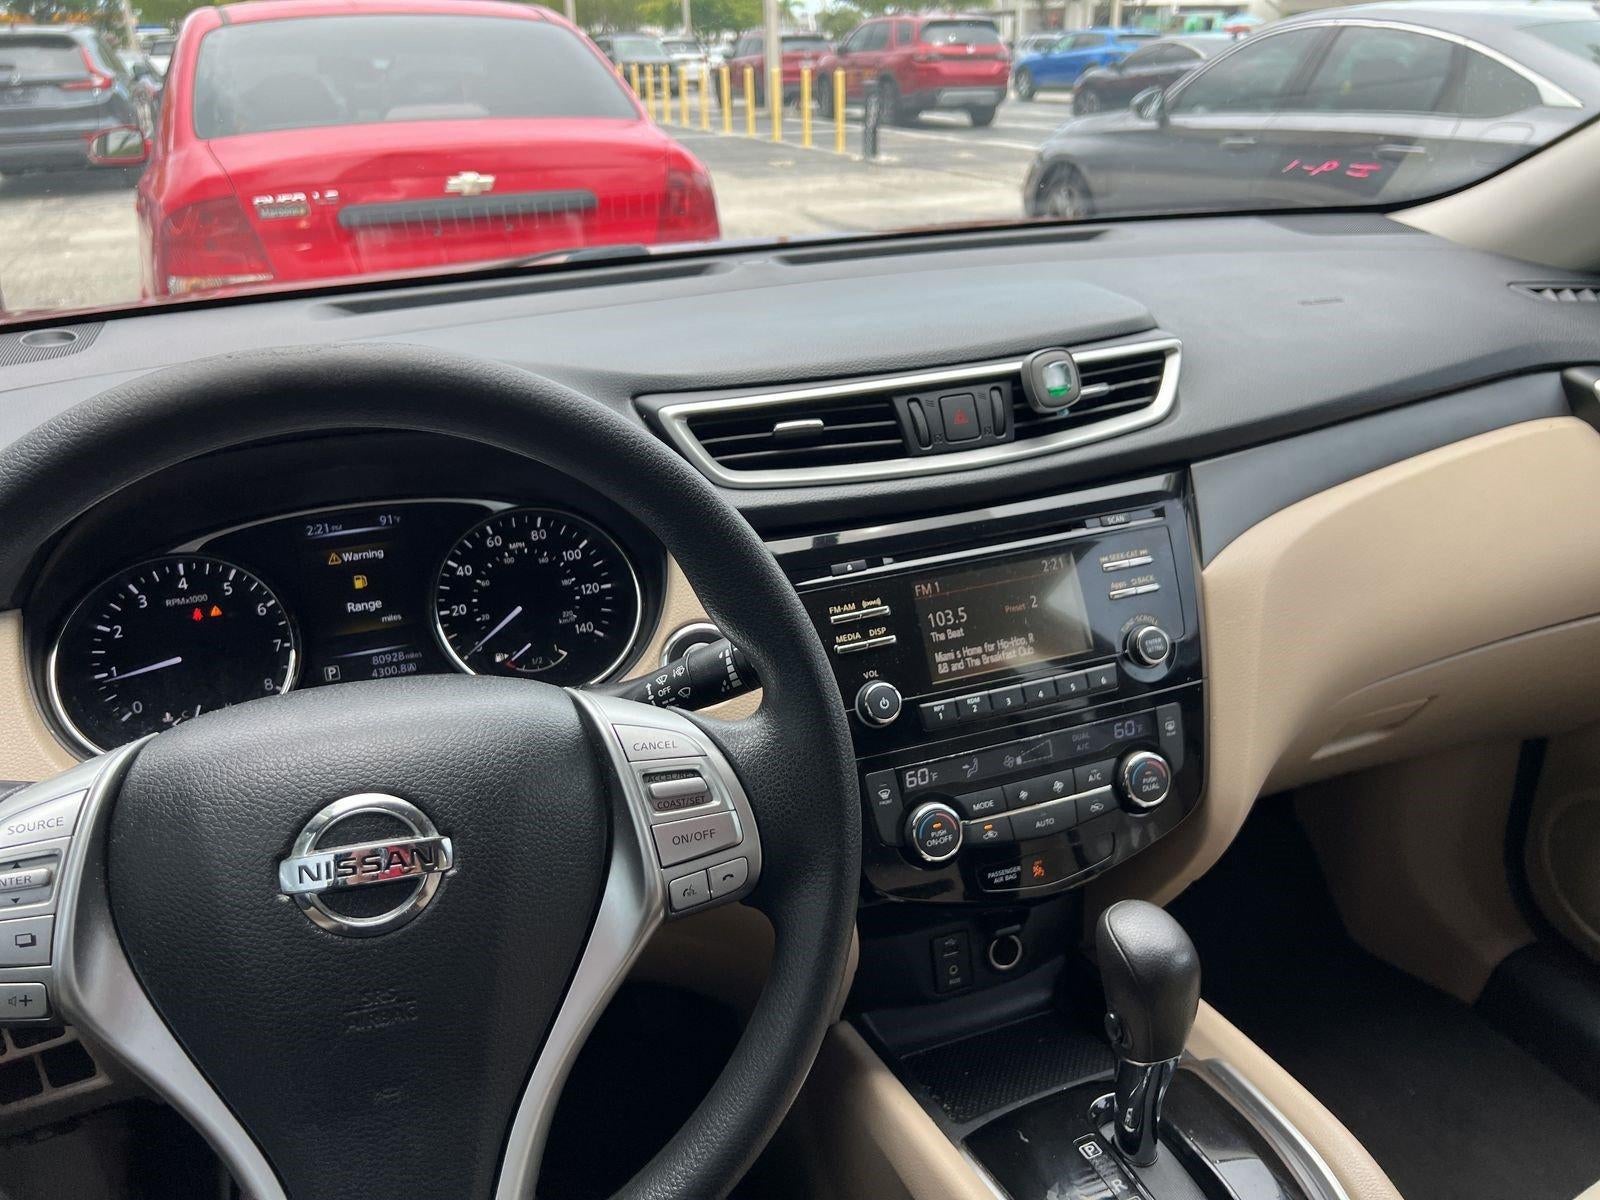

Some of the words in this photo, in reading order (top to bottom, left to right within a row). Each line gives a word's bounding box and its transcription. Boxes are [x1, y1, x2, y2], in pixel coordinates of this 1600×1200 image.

[1107, 513, 1125, 525] SCAN
[306, 523, 330, 536] 2:21
[531, 528, 547, 541] 80
[486, 535, 502, 548] 60
[509, 542, 525, 550] MPH
[342, 549, 385, 563] Warning
[562, 549, 582, 562] 100
[456, 565, 472, 577] 40
[1041, 559, 1064, 574] 2:21
[178, 577, 189, 591] 4
[223, 582, 233, 596] 5
[481, 579, 490, 587] 60
[580, 582, 600, 595] 120
[914, 582, 933, 597] FM
[137, 595, 148, 609] 3
[347, 599, 383, 613] Range
[1004, 602, 1026, 614] Preset
[1029, 595, 1038, 609] 2
[257, 604, 267, 617] 6
[451, 604, 467, 617] 20
[928, 606, 968, 628] 103.5
[381, 614, 402, 623] miles
[113, 625, 124, 639] 2
[575, 621, 594, 634] 140
[868, 626, 887, 637] DISP
[835, 631, 862, 643] MEDIA
[930, 630, 946, 643] The
[947, 627, 965, 640] Beat
[273, 639, 282, 653] 7
[963, 644, 983, 658] Home
[984, 641, 996, 654] for
[1028, 632, 1034, 642] R
[950, 659, 965, 672] and
[966, 656, 981, 669] The
[982, 649, 1017, 665] Breakfast
[110, 666, 118, 678] 1
[862, 669, 879, 680] VOL
[264, 678, 274, 691] 8
[1101, 675, 1107, 685] 6
[657, 686, 672, 697] OFF
[1037, 690, 1044, 698] 4
[1070, 683, 1076, 692] 5
[132, 701, 143, 713] 0
[1006, 697, 1011, 706] 3
[972, 704, 978, 713] 2
[938, 712, 943, 721] 1
[1072, 732, 1091, 743] DUAL
[632, 739, 678, 752] CANCEL
[1088, 772, 1102, 783] A/C
[1142, 783, 1160, 793] DUAL
[657, 795, 706, 809] COAST/SET
[972, 799, 995, 811] MODE
[7, 816, 65, 835] SOURCE
[1035, 816, 1055, 828] AUTO
[671, 827, 717, 847] ON/OFF
[930, 829, 947, 838] PUSH
[296, 845, 437, 884] NISSAN
[987, 865, 1022, 879] PASSENGER
[1111, 1179, 1128, 1194] R
